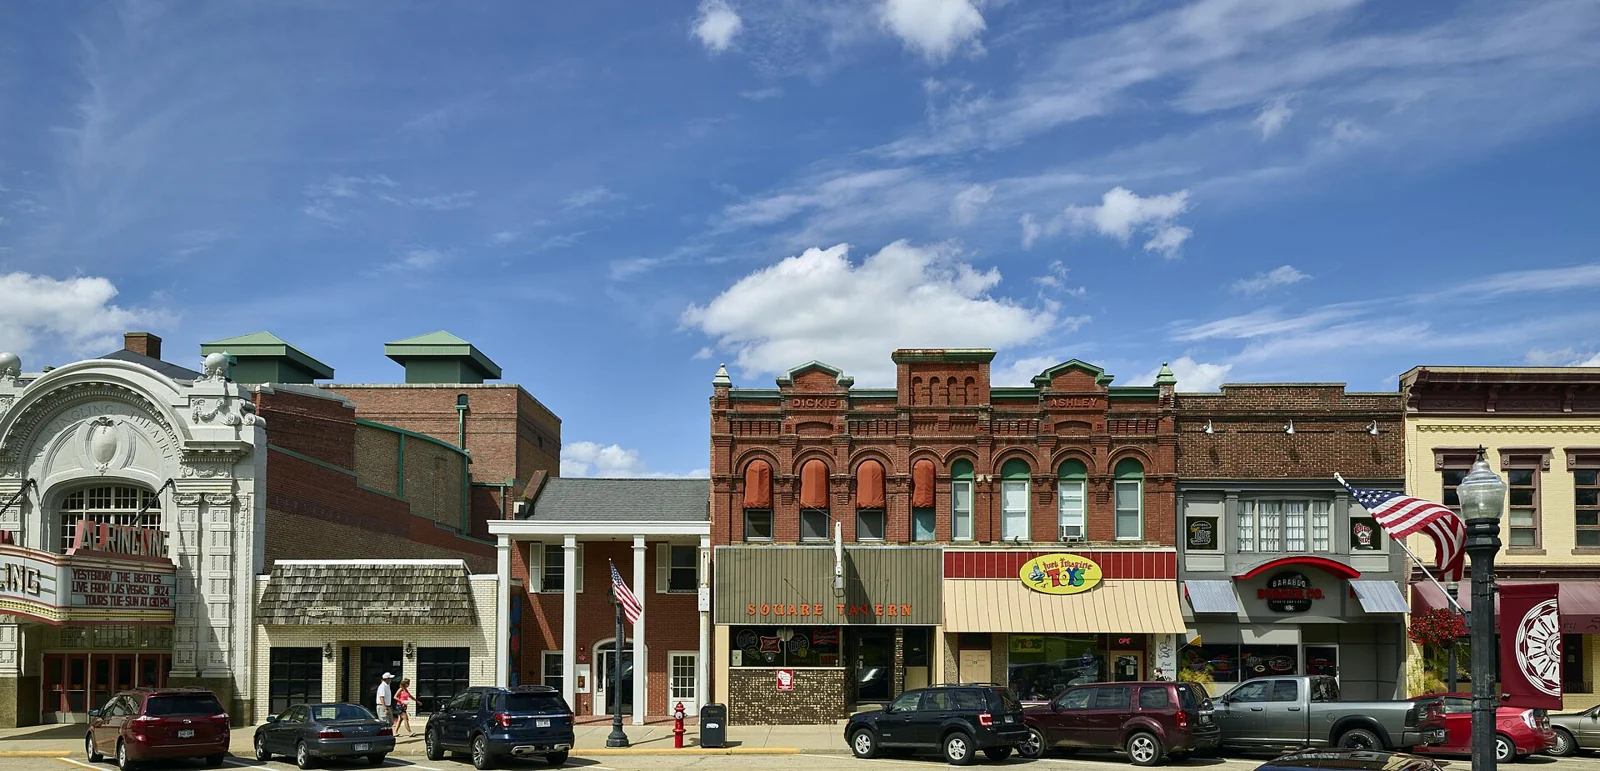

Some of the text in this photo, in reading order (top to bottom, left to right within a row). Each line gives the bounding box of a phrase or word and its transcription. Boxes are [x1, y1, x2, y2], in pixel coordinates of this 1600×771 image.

[793, 399, 837, 408] DICKIE
[1051, 398, 1097, 408] ASHLEY
[129, 411, 174, 461] THEATRE
[105, 524, 170, 558] RINGLING
[1060, 557, 1093, 570] Imagine
[72, 568, 161, 585] YESTERDAY THE BEATLES
[1047, 567, 1086, 587] TOYS
[1272, 578, 1307, 588] BARABOO
[72, 581, 88, 593] LIVE
[90, 582, 109, 594] FROM
[112, 583, 125, 594] LAS
[1257, 588, 1326, 599] BURGER CO.
[84, 594, 109, 606] TOURS
[747, 603, 912, 617] SQUARE TAVERN
